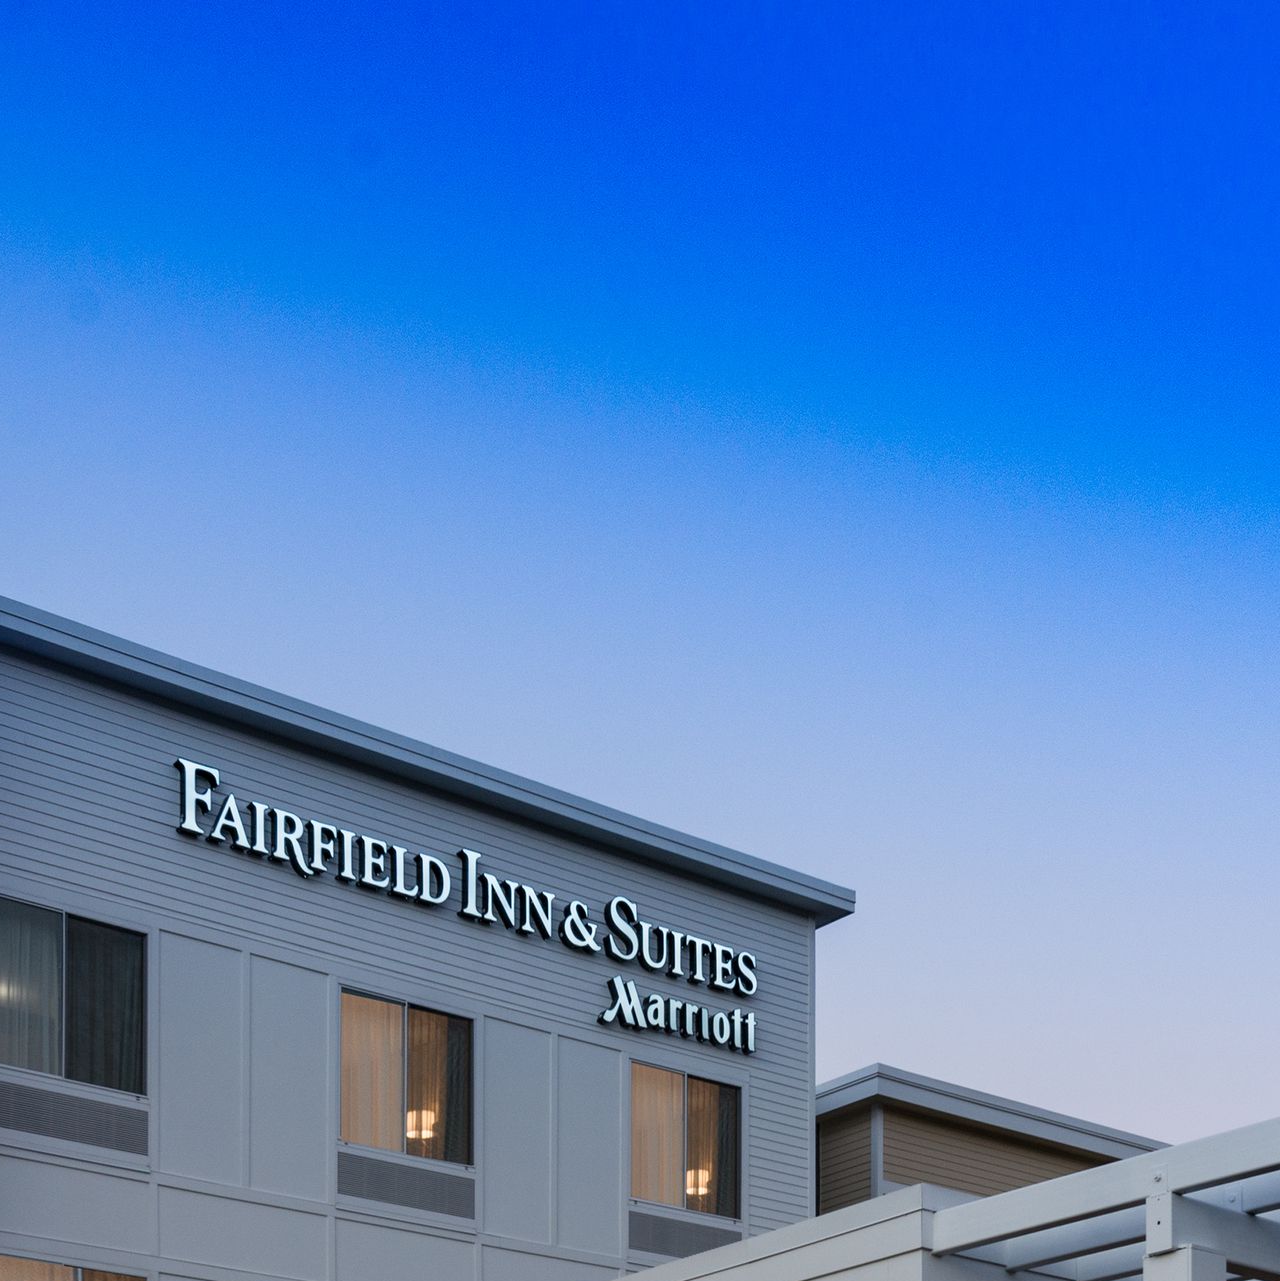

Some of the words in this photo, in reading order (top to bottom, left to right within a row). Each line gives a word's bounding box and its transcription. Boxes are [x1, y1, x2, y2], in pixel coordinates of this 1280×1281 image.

[174, 758, 452, 906] FAIRFIELD
[458, 849, 555, 938] INN
[559, 901, 601, 953] &
[604, 897, 757, 997] SUITES
[598, 976, 756, 1054] Marriott
